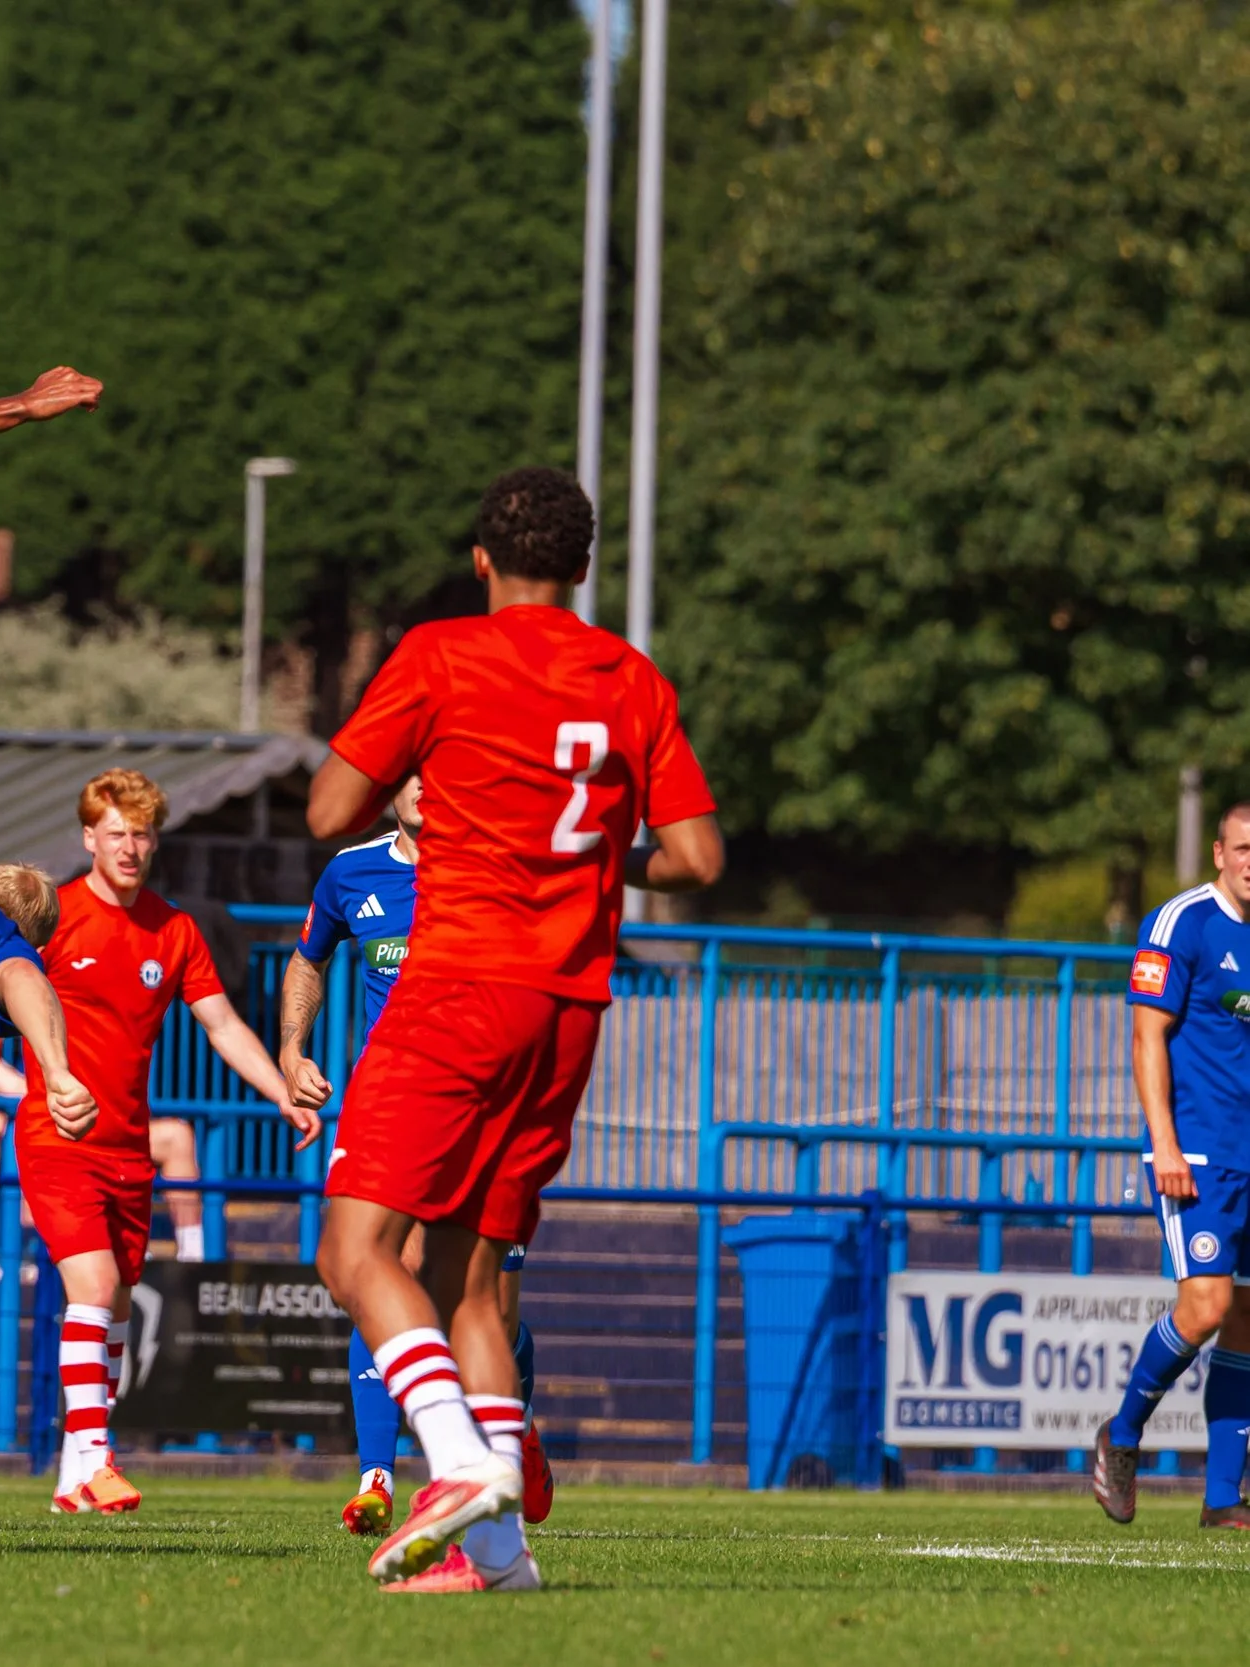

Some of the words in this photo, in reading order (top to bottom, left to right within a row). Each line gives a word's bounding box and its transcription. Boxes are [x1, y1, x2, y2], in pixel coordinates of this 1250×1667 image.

[550, 721, 610, 854] 2
[896, 1290, 1024, 1390] MG
[1031, 1295, 1141, 1325] APPLIANCE
[899, 1400, 1019, 1427] DOMESTIC
